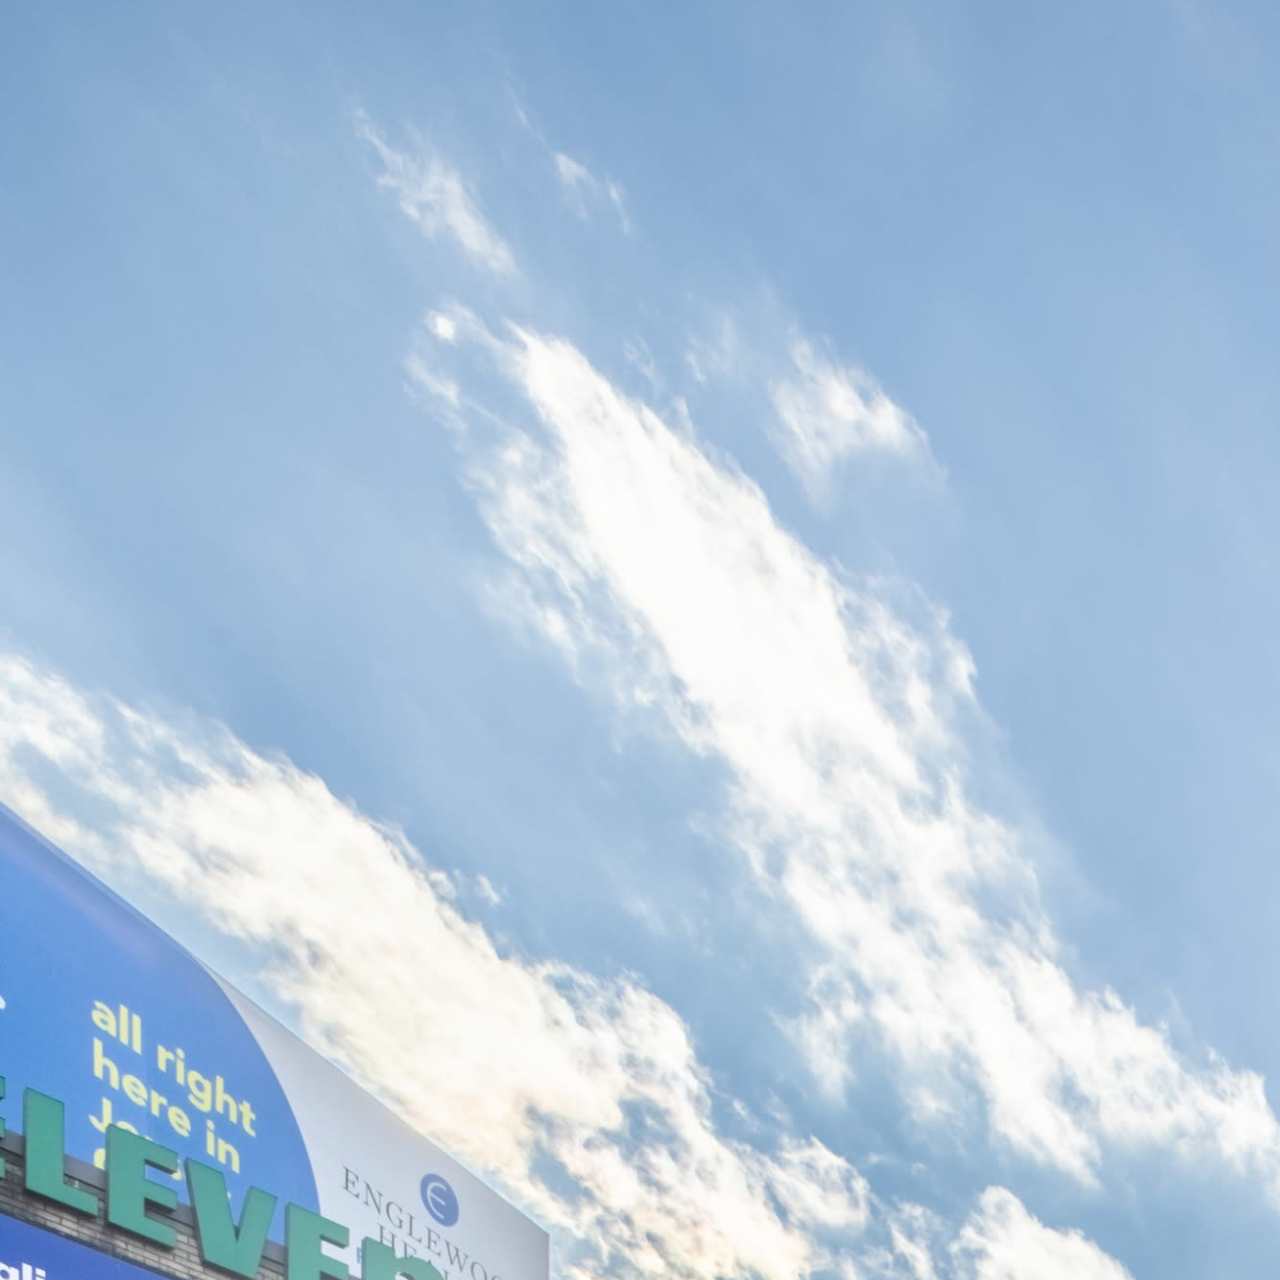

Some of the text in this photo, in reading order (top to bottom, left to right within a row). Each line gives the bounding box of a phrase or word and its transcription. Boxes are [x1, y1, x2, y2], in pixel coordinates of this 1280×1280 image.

[91, 1000, 256, 1137] all right
[93, 1037, 191, 1137] here
[205, 1119, 240, 1174] in
